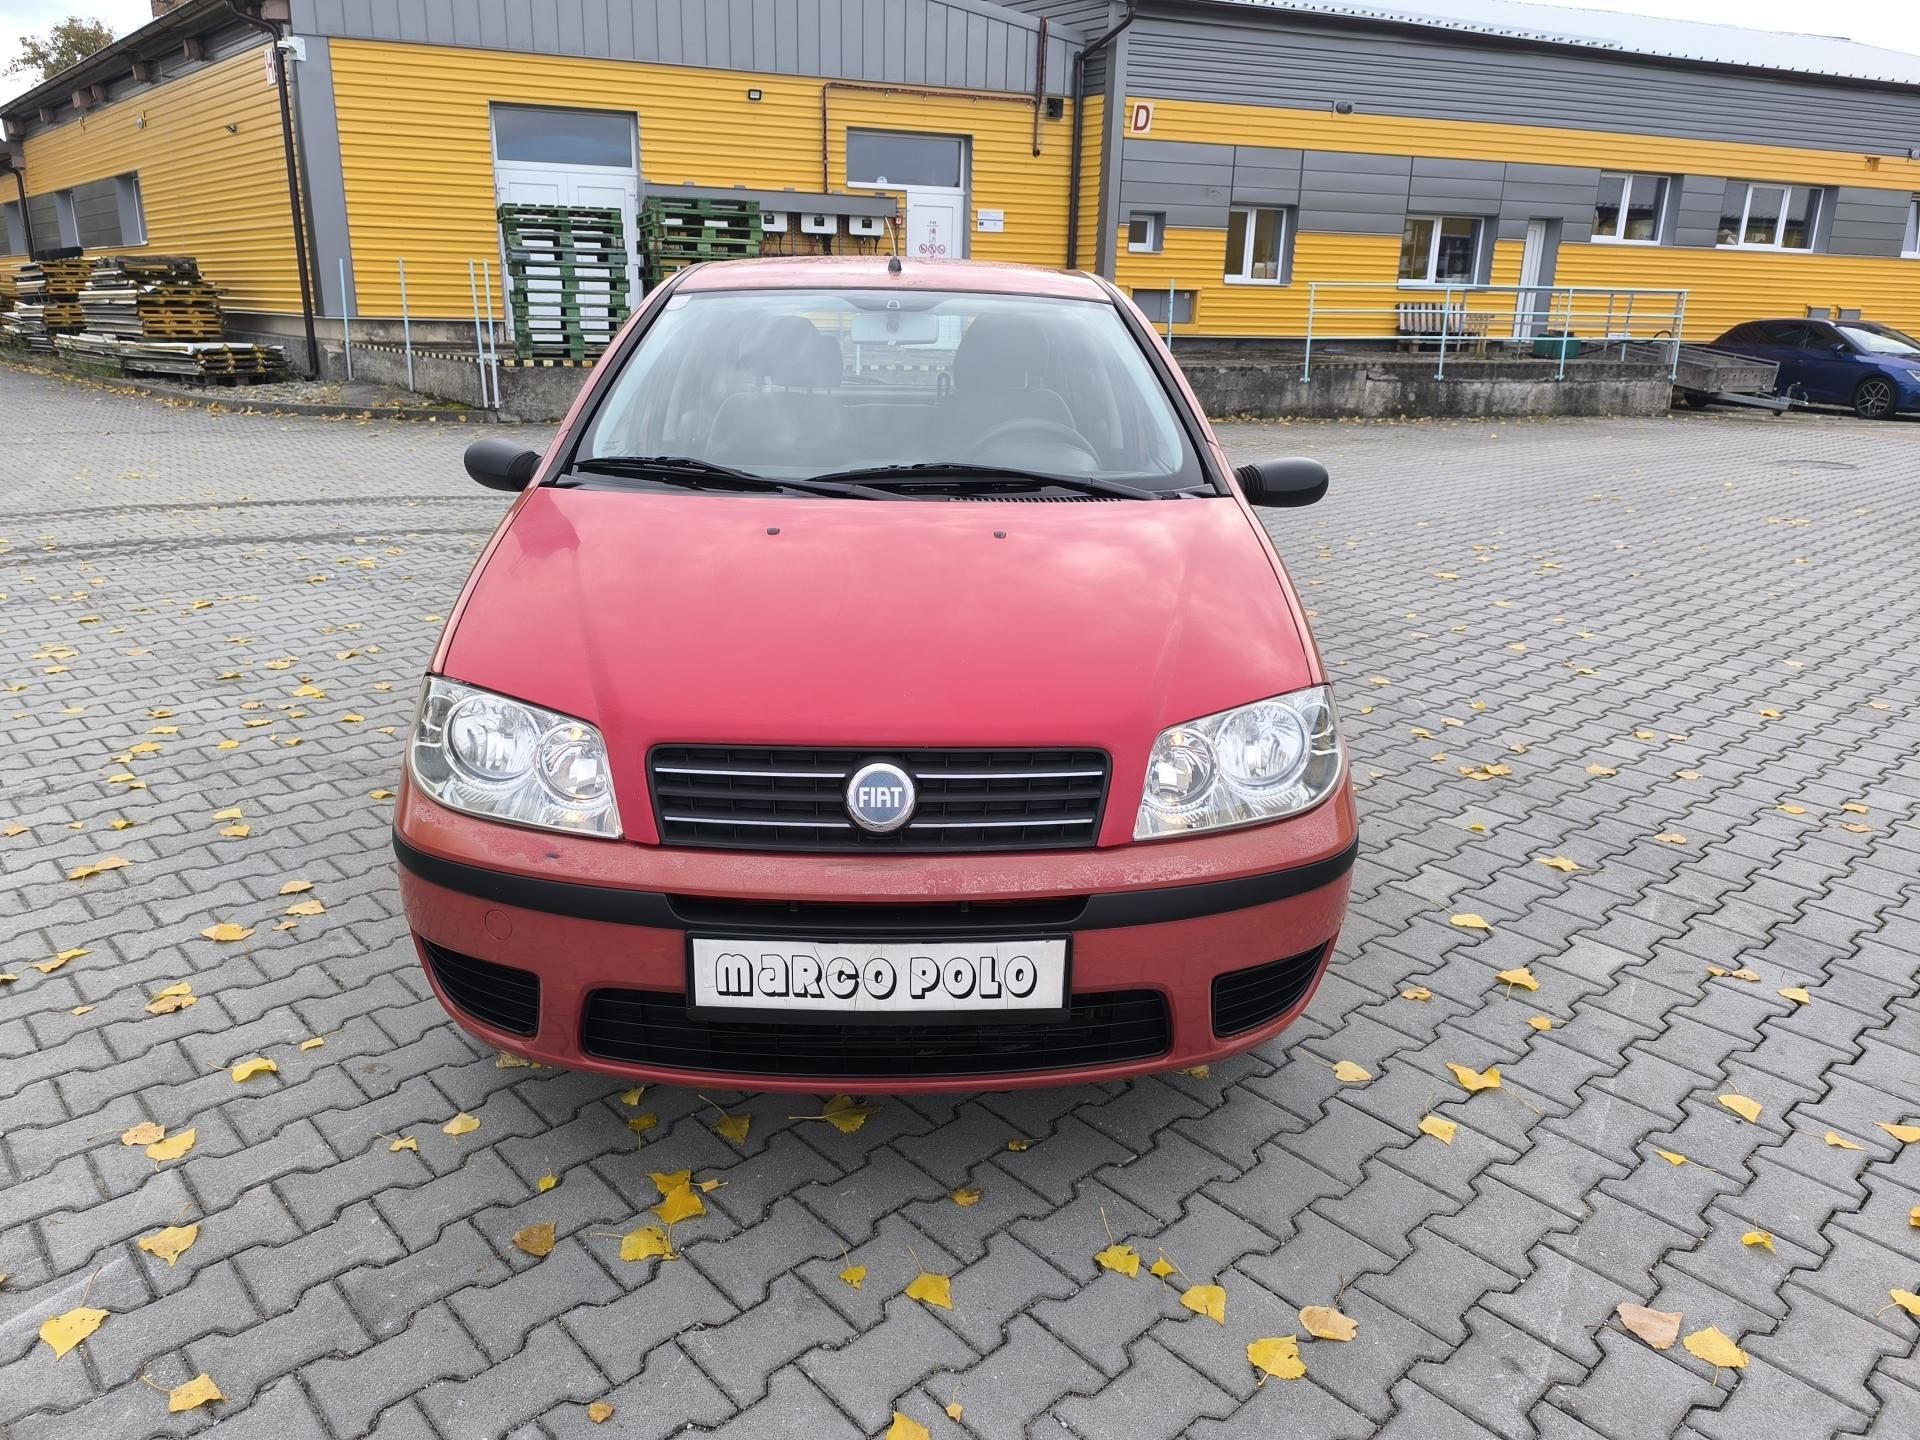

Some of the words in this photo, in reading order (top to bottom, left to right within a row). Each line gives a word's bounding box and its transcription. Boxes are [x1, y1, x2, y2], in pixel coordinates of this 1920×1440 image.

[1133, 105, 1150, 131] D
[858, 786, 903, 808] FIAT
[910, 955, 1038, 1000] POLO
